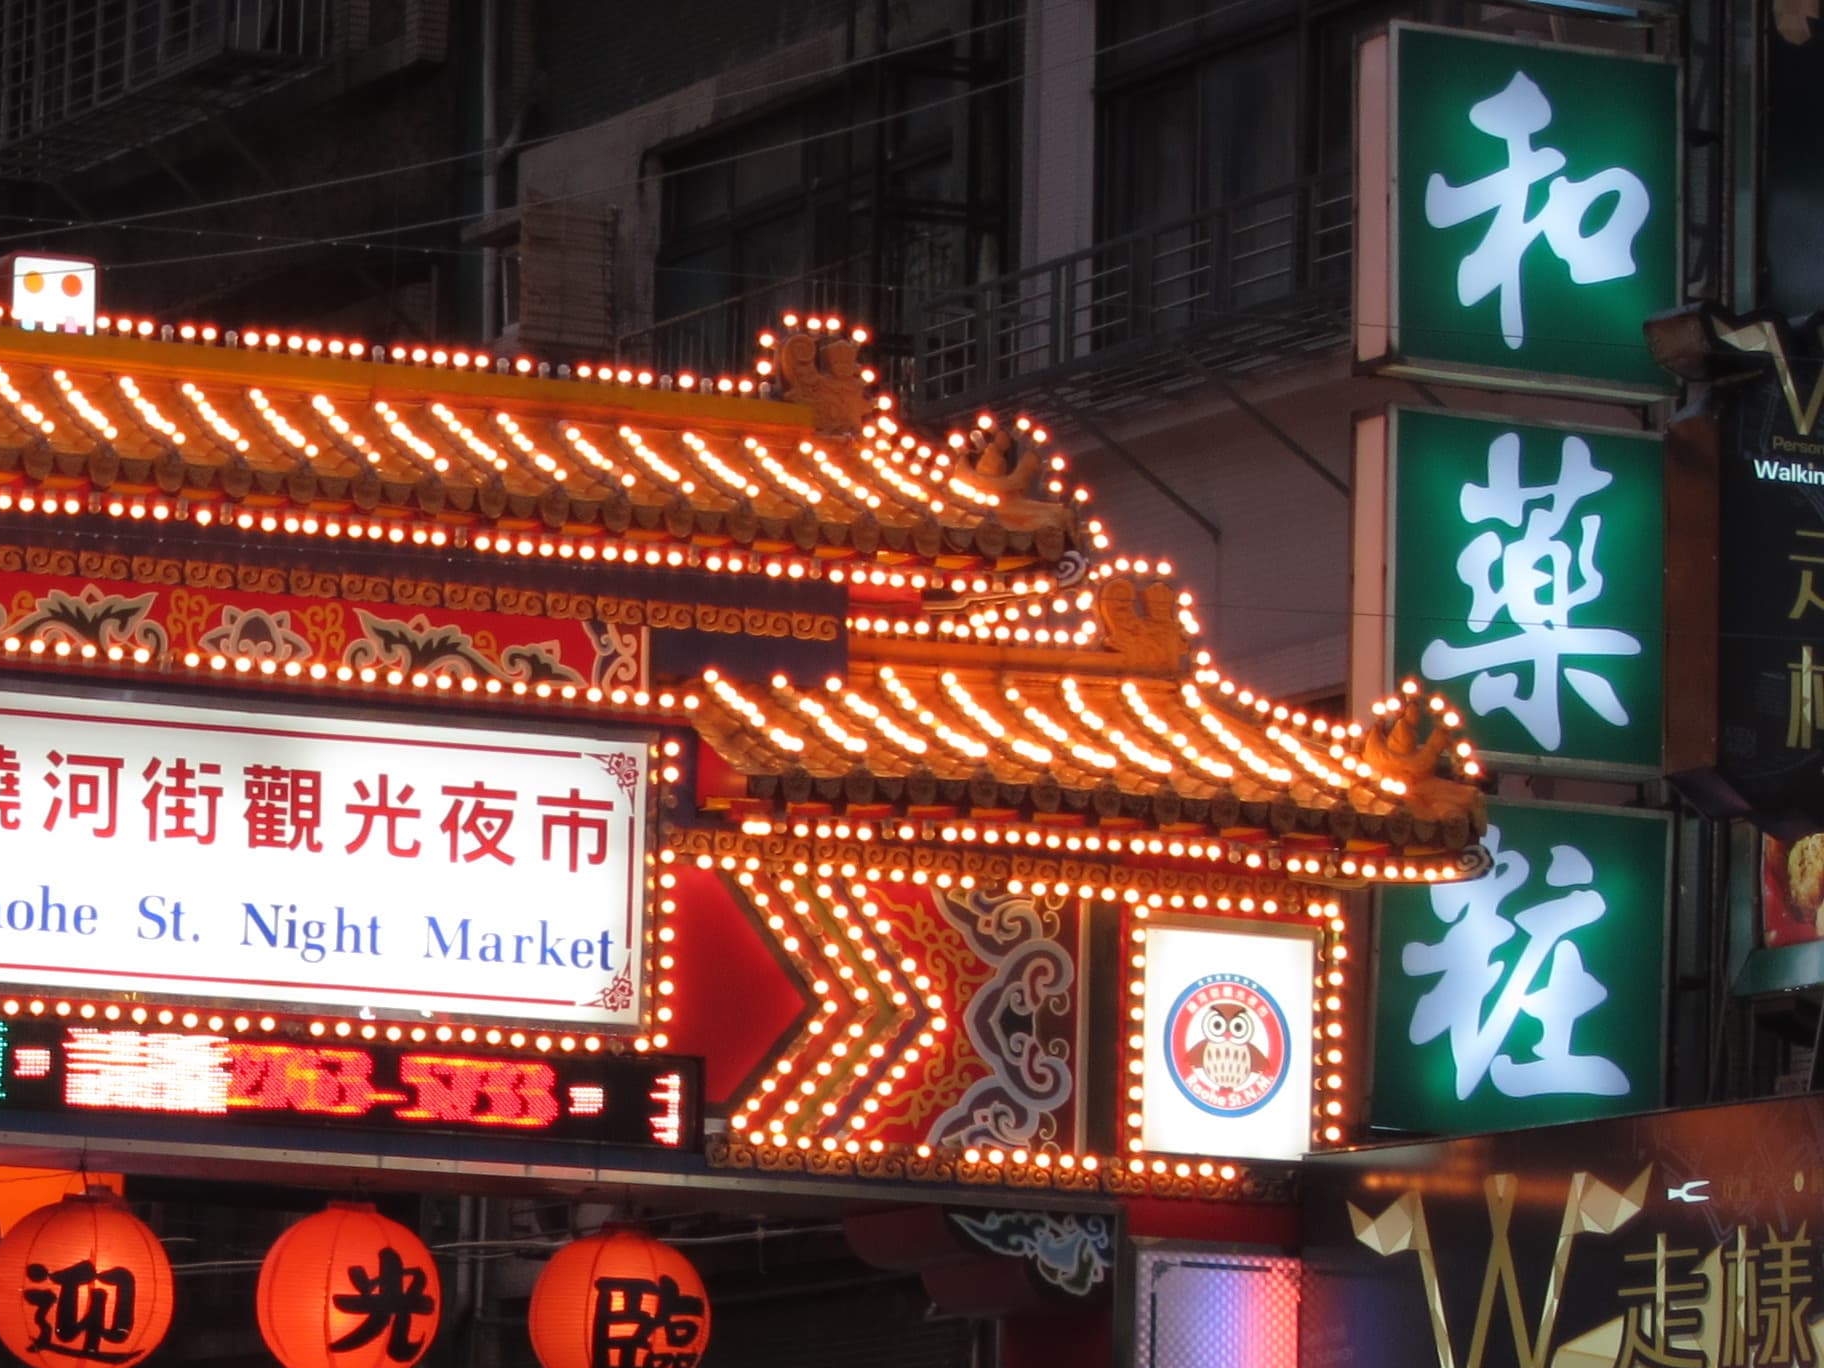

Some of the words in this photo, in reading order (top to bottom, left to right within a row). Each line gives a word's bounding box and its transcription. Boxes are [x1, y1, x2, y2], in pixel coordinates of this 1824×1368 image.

[137, 893, 200, 945] St.
[239, 902, 382, 965] Night
[424, 914, 615, 972] Market
[24, 1253, 146, 1366] 迎
[328, 1247, 435, 1363] 光
